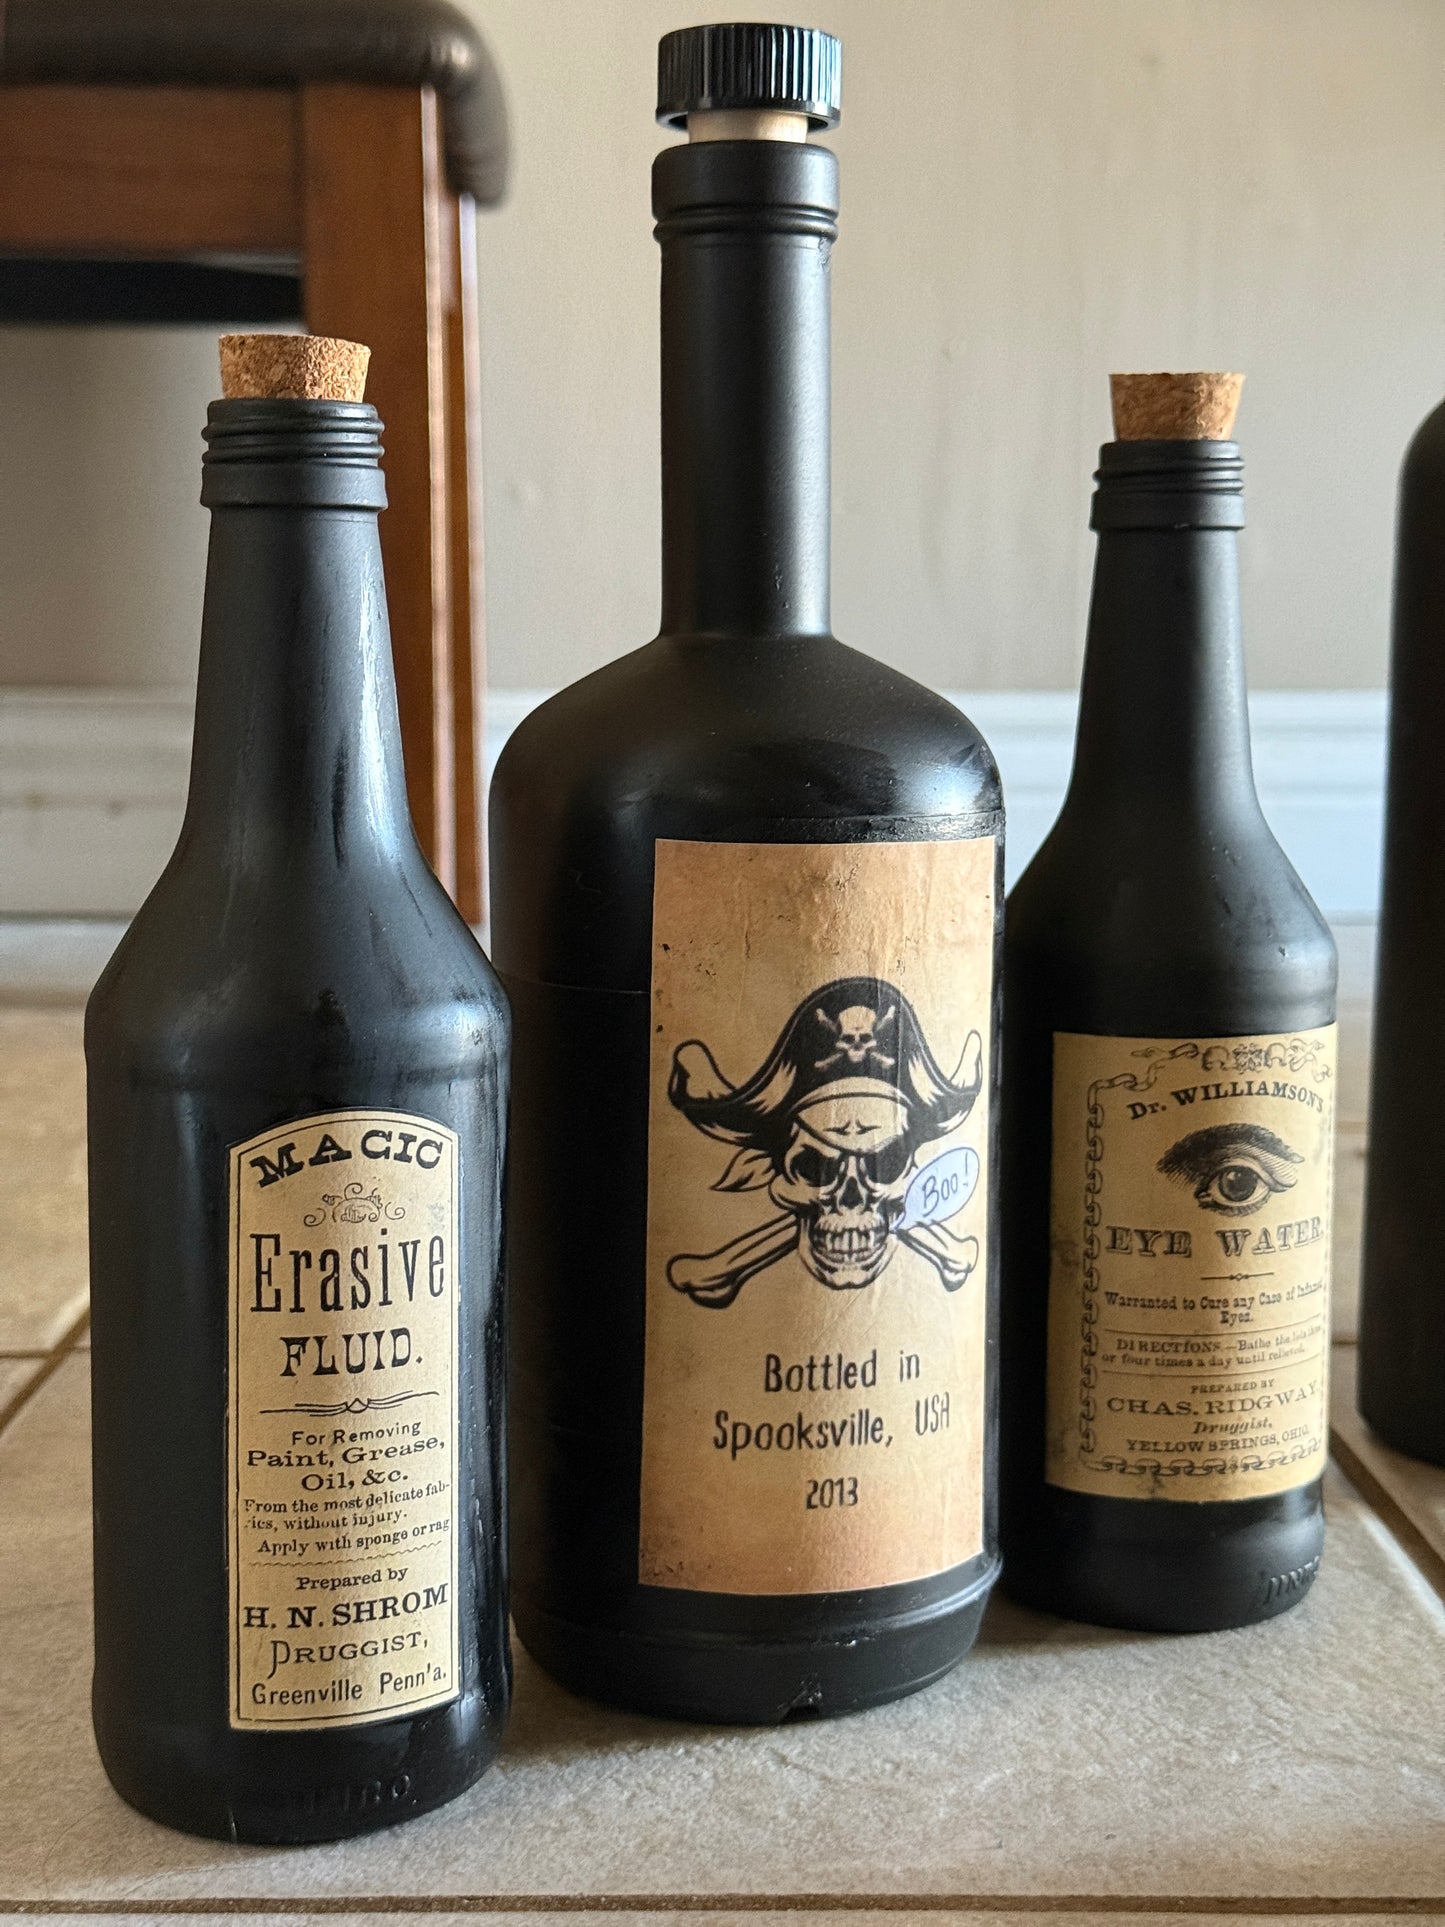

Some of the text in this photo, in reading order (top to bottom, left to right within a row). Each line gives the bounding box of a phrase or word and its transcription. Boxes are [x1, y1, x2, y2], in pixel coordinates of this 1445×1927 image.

[1127, 1101, 1167, 1120] Dr.
[249, 1129, 444, 1188] MAGIC
[922, 1151, 969, 1218] Boo!
[1105, 1225, 1192, 1258] EYE
[250, 1228, 444, 1313] Erasive
[1104, 1291, 1178, 1310] Warranted
[1183, 1297, 1197, 1311] to
[1200, 1296, 1230, 1310] Cure
[1233, 1296, 1255, 1309] any
[280, 1327, 423, 1377] FLUID.
[1155, 1356, 1193, 1367] times
[1208, 1355, 1232, 1370] day
[1236, 1351, 1265, 1365] until
[765, 1348, 920, 1393] Bottled in
[1190, 1378, 1275, 1395] PREPARED BY
[1107, 1397, 1199, 1416] CHAS.
[292, 1422, 421, 1445] For Removing
[713, 1392, 951, 1460] Spooksville, USA
[247, 1437, 445, 1468] Paint, Grease,
[1127, 1439, 1205, 1454] YELLOW
[244, 1480, 450, 1513] From the most delicate fab-
[301, 1469, 408, 1491] Oil, &c.
[806, 1477, 859, 1510] 2013
[283, 1516, 348, 1530] without
[353, 1509, 407, 1528] injury.
[257, 1518, 450, 1556] Apply with sponge or rag
[296, 1567, 409, 1591] Prepared by
[243, 1582, 449, 1629] H. N. SHROM
[267, 1631, 428, 1679] DRUGGIST,
[252, 1662, 447, 1705] Greenville Penn'a.
